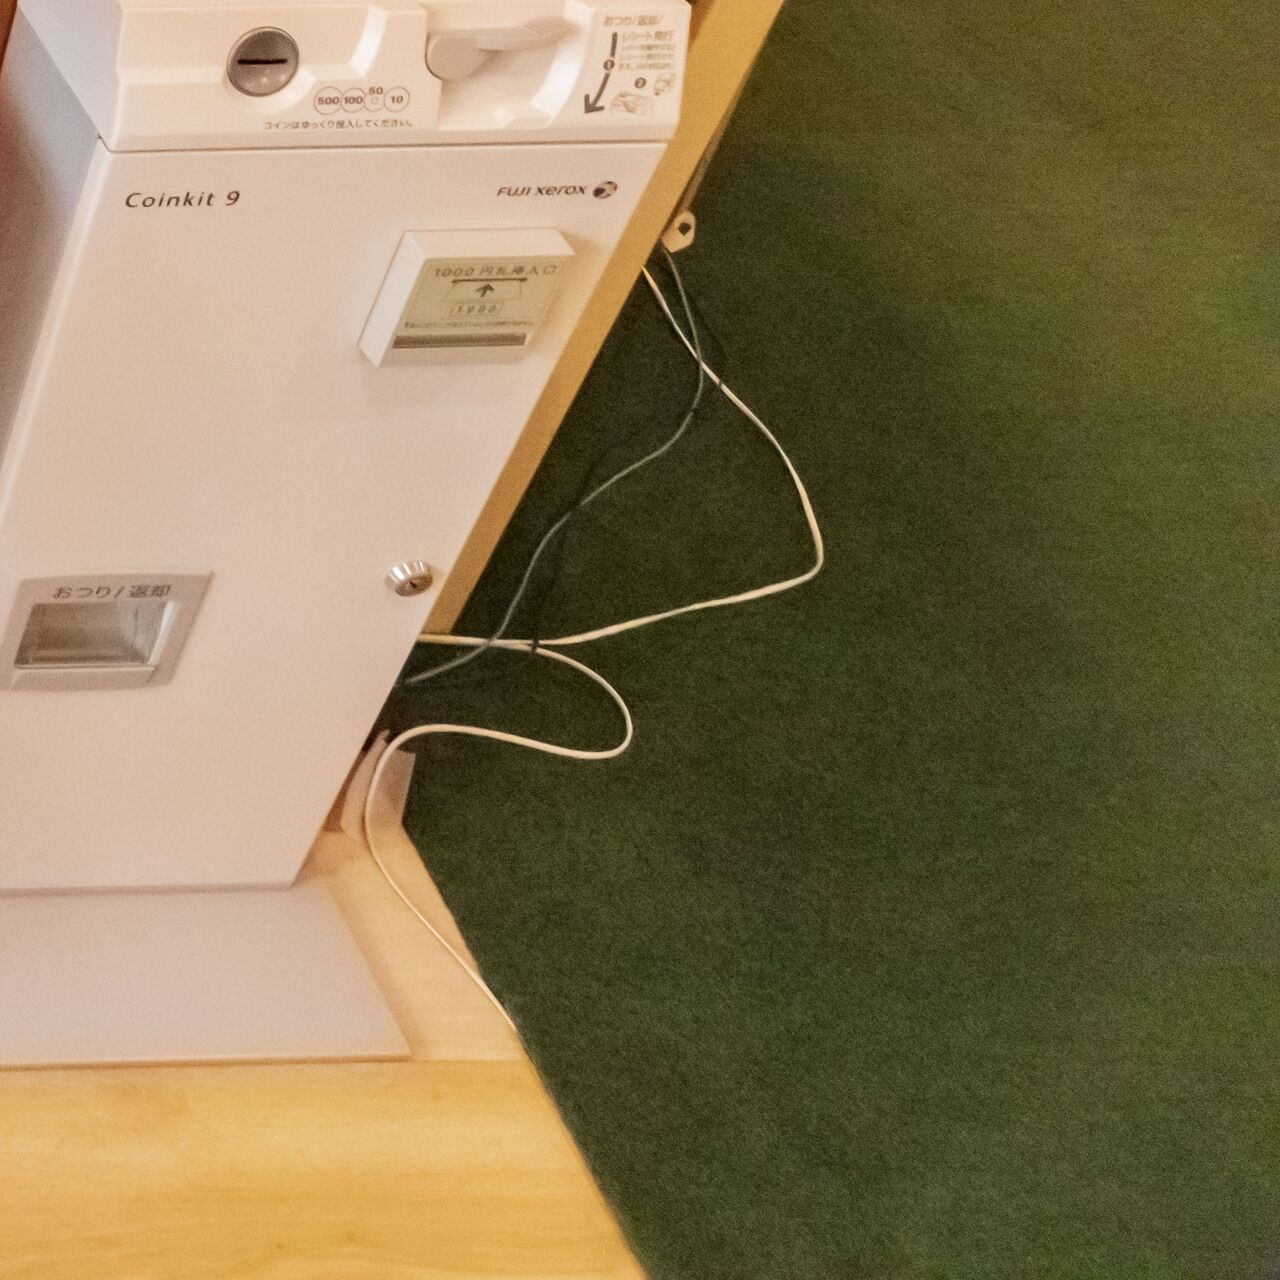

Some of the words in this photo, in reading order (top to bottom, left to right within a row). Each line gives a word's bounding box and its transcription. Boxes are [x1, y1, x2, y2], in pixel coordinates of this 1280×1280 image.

[368, 86, 384, 95] 50
[317, 96, 339, 105] 500
[344, 95, 364, 105] 100
[391, 95, 404, 104] 10
[497, 186, 532, 196] FUJI
[125, 191, 215, 208] Coinkit
[225, 190, 240, 206] 9
